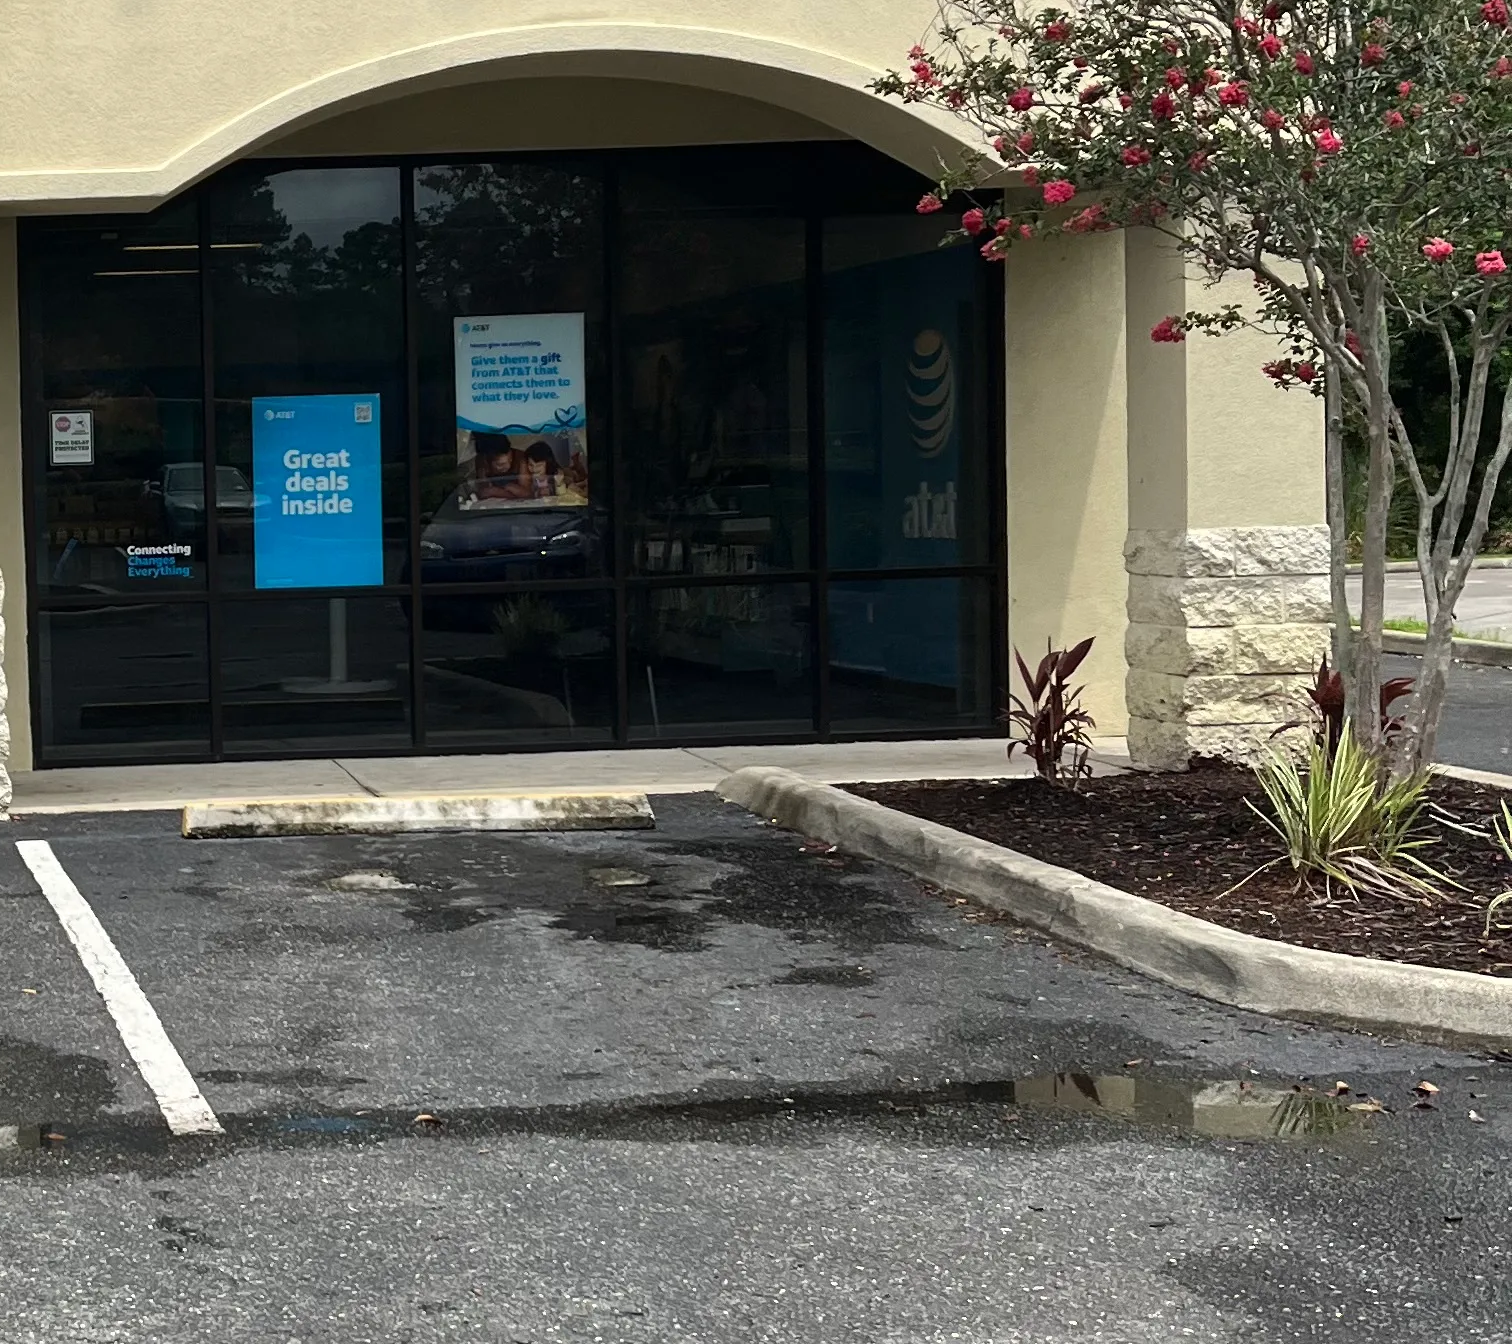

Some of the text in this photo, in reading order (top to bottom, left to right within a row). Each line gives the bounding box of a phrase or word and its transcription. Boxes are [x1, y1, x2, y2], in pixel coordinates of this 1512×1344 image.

[471, 356, 497, 366] Give
[499, 355, 529, 365] them
[541, 352, 562, 366] gift
[471, 365, 559, 378] from AT&T that
[471, 378, 571, 391] connects them to
[472, 390, 560, 403] what they love.
[283, 449, 351, 469] Great
[285, 470, 349, 492] deals
[282, 493, 353, 515] inside
[127, 543, 191, 556] Connecting
[128, 556, 175, 567] Changes
